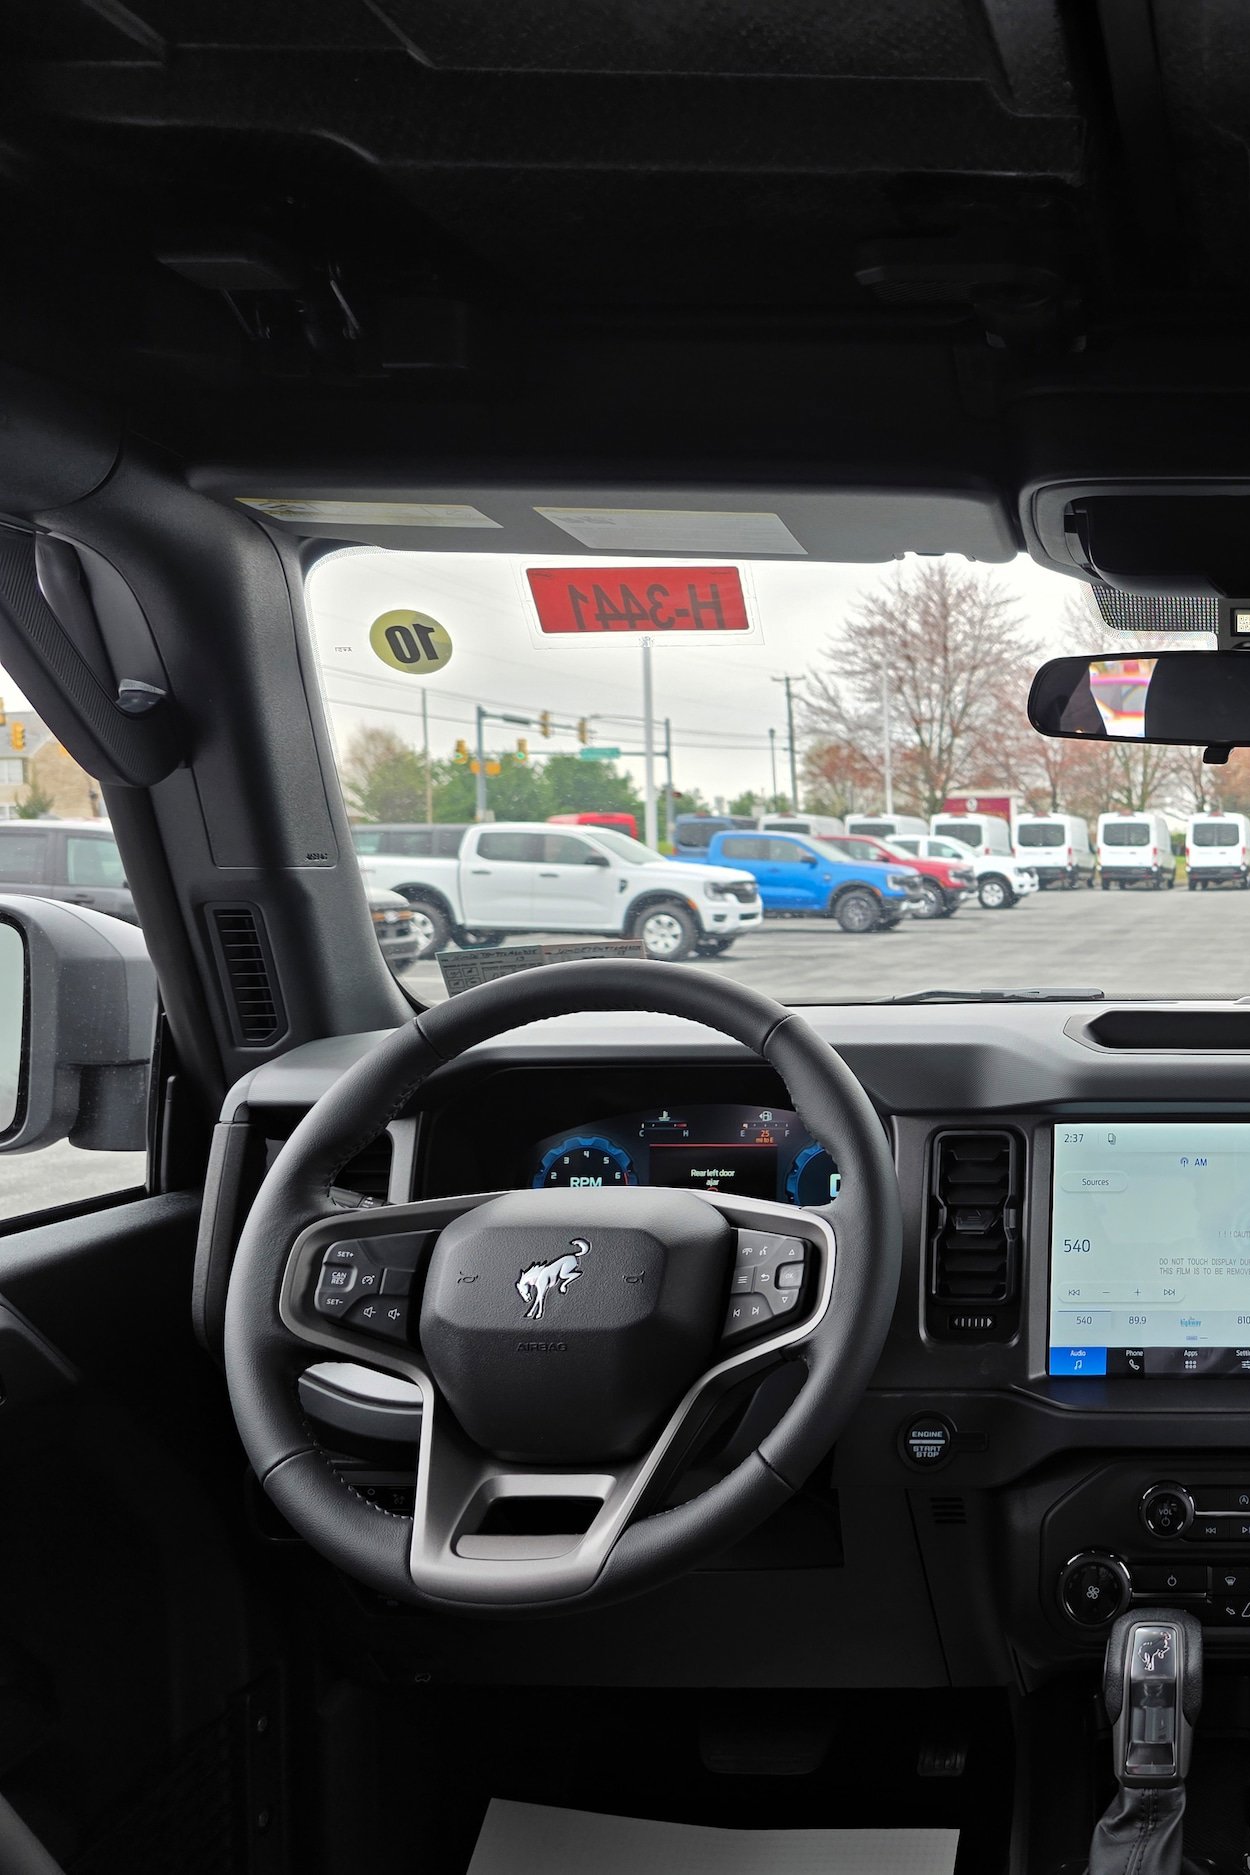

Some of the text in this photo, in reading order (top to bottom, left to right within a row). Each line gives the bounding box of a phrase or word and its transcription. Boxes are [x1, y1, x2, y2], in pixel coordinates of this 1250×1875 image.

[760, 1129, 770, 1137] 25
[1064, 1133, 1084, 1143] 2:37
[583, 1150, 590, 1158] 4
[563, 1156, 570, 1165] 3
[603, 1156, 610, 1165] 5
[1194, 1158, 1208, 1166] AM
[550, 1171, 557, 1180] 2
[614, 1171, 621, 1180] 6
[690, 1168, 735, 1177] Rear left door
[569, 1176, 603, 1188] RPM
[705, 1179, 720, 1187] ajar
[1082, 1178, 1109, 1186] Sources
[1063, 1239, 1091, 1253] 540
[1159, 1258, 1169, 1266] DO
[1171, 1258, 1185, 1266] NOT
[1187, 1258, 1208, 1266] TOUCH
[1211, 1258, 1237, 1266] DISPLAY
[1159, 1267, 1174, 1275] THIS
[1176, 1267, 1191, 1275] FILM
[1193, 1267, 1200, 1275] IS
[1203, 1267, 1212, 1276] TO
[1214, 1267, 1223, 1276] BE
[1075, 1315, 1093, 1325] 540
[1128, 1315, 1147, 1325] 89.9
[516, 1341, 568, 1352] AIRBAG
[1070, 1349, 1087, 1357] Audio
[1125, 1349, 1144, 1357] Phone
[1183, 1349, 1198, 1358] Apps
[911, 1430, 944, 1438] ENGINE
[1158, 1508, 1173, 1516] VOL
